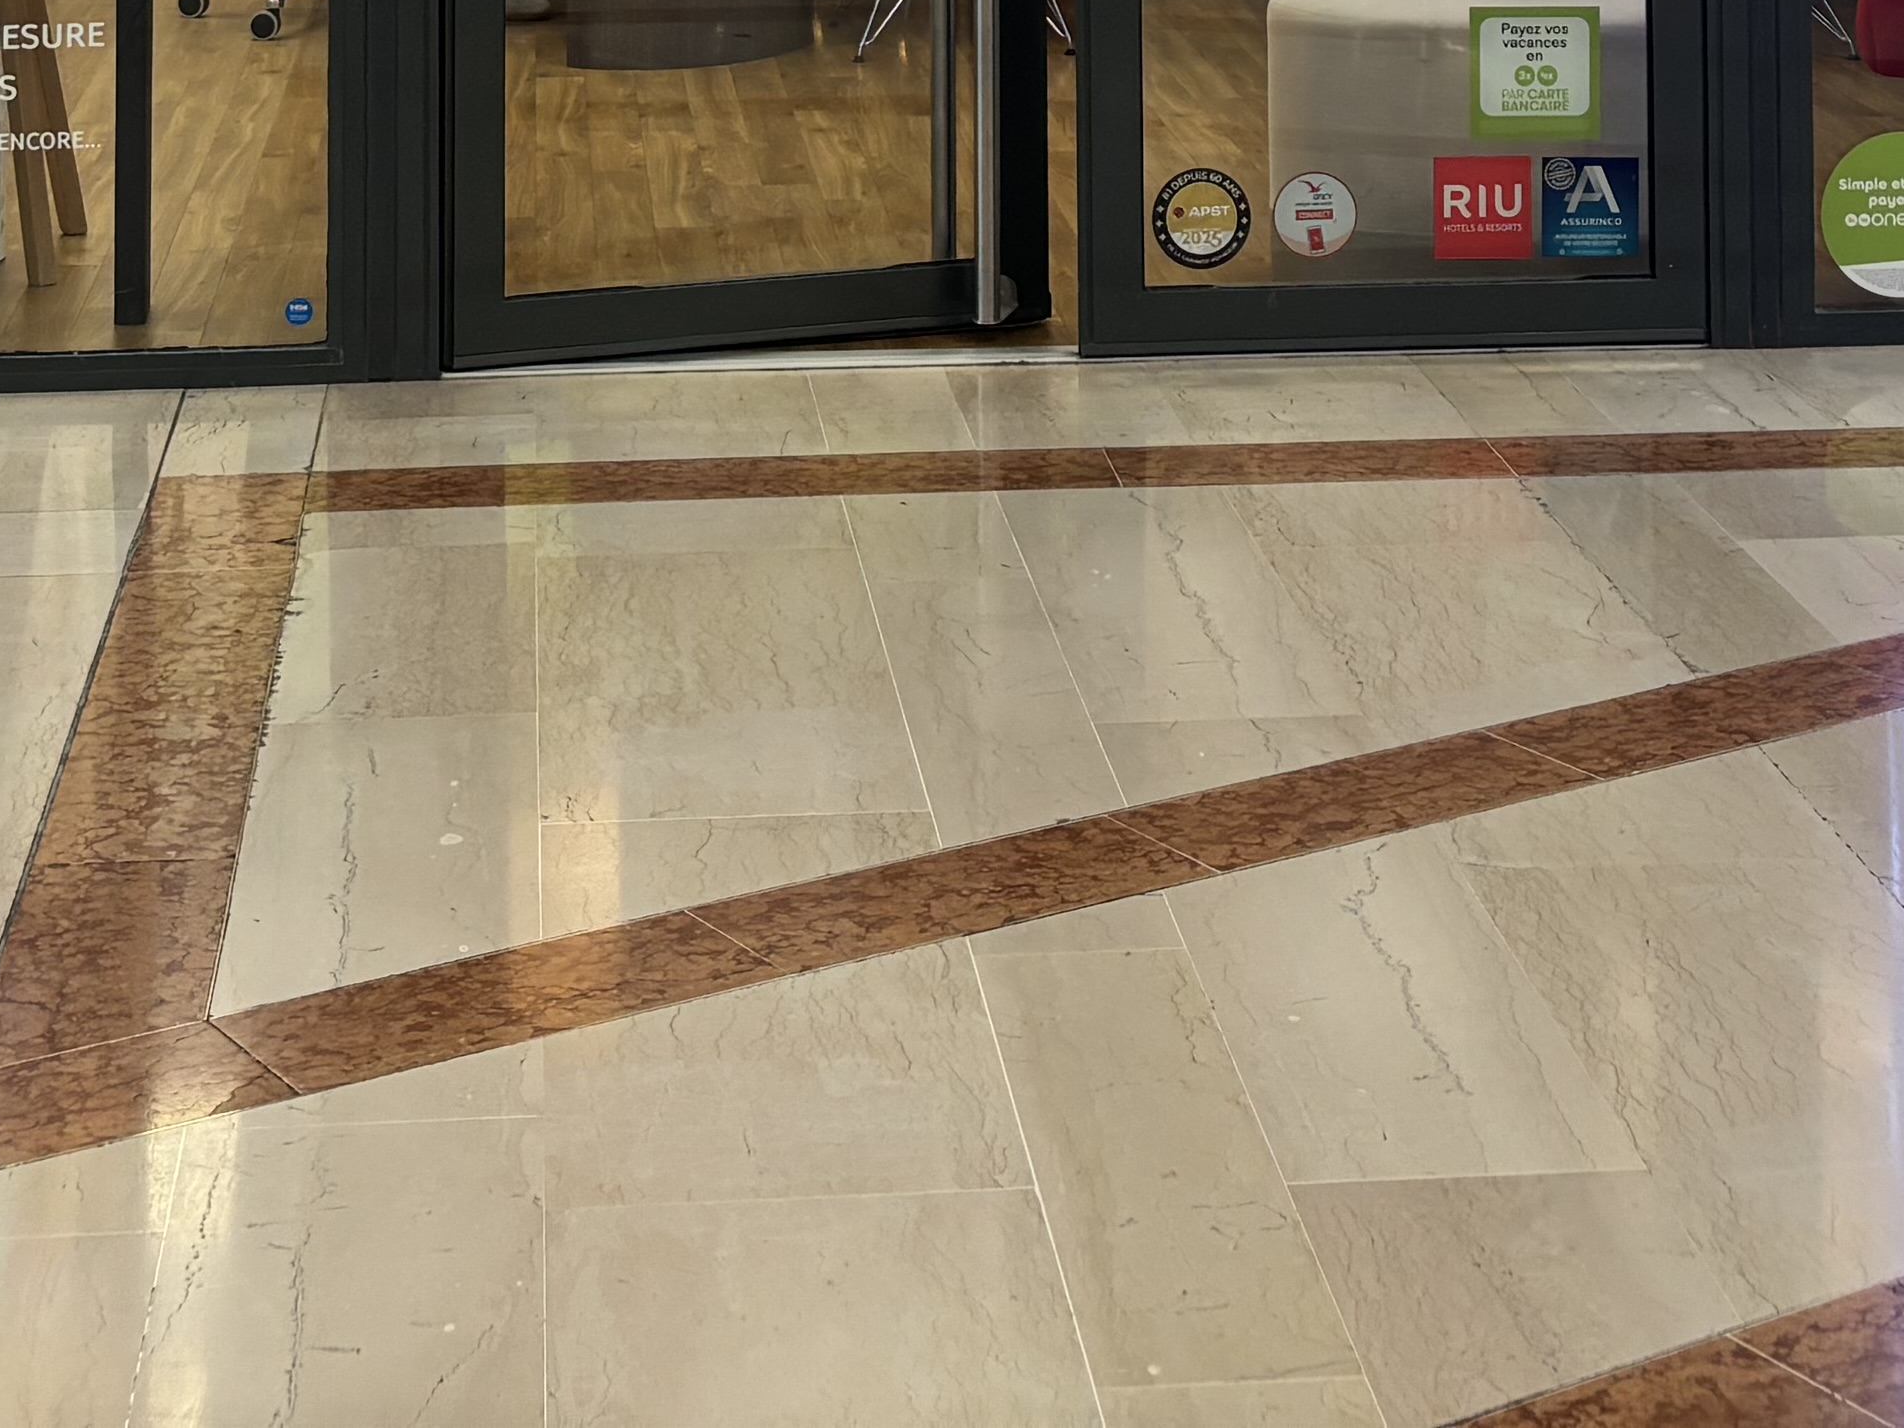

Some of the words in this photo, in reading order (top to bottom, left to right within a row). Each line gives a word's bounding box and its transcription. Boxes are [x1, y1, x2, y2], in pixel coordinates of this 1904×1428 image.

[1501, 22, 1541, 38] Payez
[1545, 25, 1569, 35] vos
[1502, 38, 1567, 48] vacances
[1526, 52, 1543, 61] en
[1502, 88, 1525, 99] PAR
[1527, 88, 1569, 100] CARTE
[1501, 100, 1569, 112] BANCAIRE
[1839, 177, 1888, 193] Simple
[1443, 183, 1522, 219] RIU
[1188, 205, 1231, 217] APST
